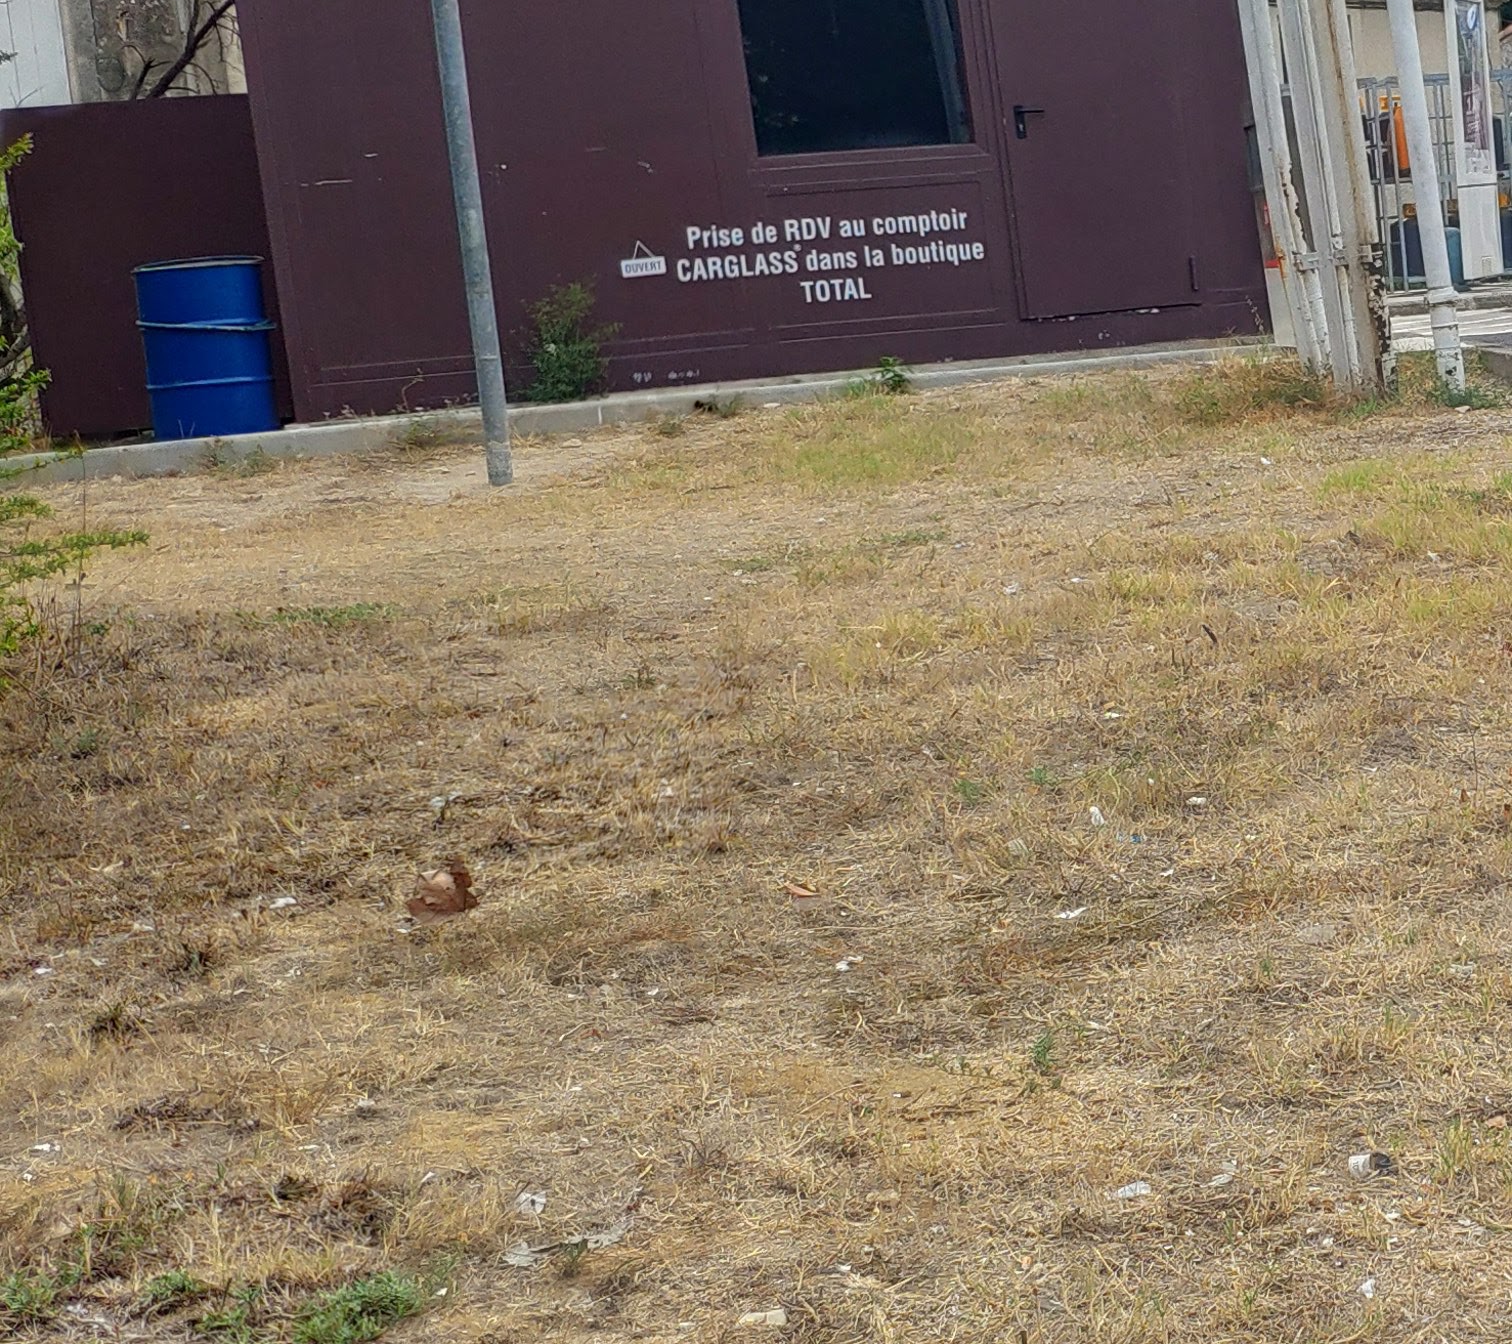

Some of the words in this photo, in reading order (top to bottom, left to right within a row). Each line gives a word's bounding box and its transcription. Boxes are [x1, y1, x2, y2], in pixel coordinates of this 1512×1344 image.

[686, 224, 744, 250] Prise
[751, 222, 777, 244] de
[784, 216, 831, 242] RDV
[839, 219, 866, 238] au
[872, 208, 967, 237] comptoir
[624, 259, 662, 274] OUVERT
[806, 249, 857, 272] dans
[864, 245, 885, 267] la
[891, 240, 985, 266] boutique
[800, 277, 872, 303] TOTAL
